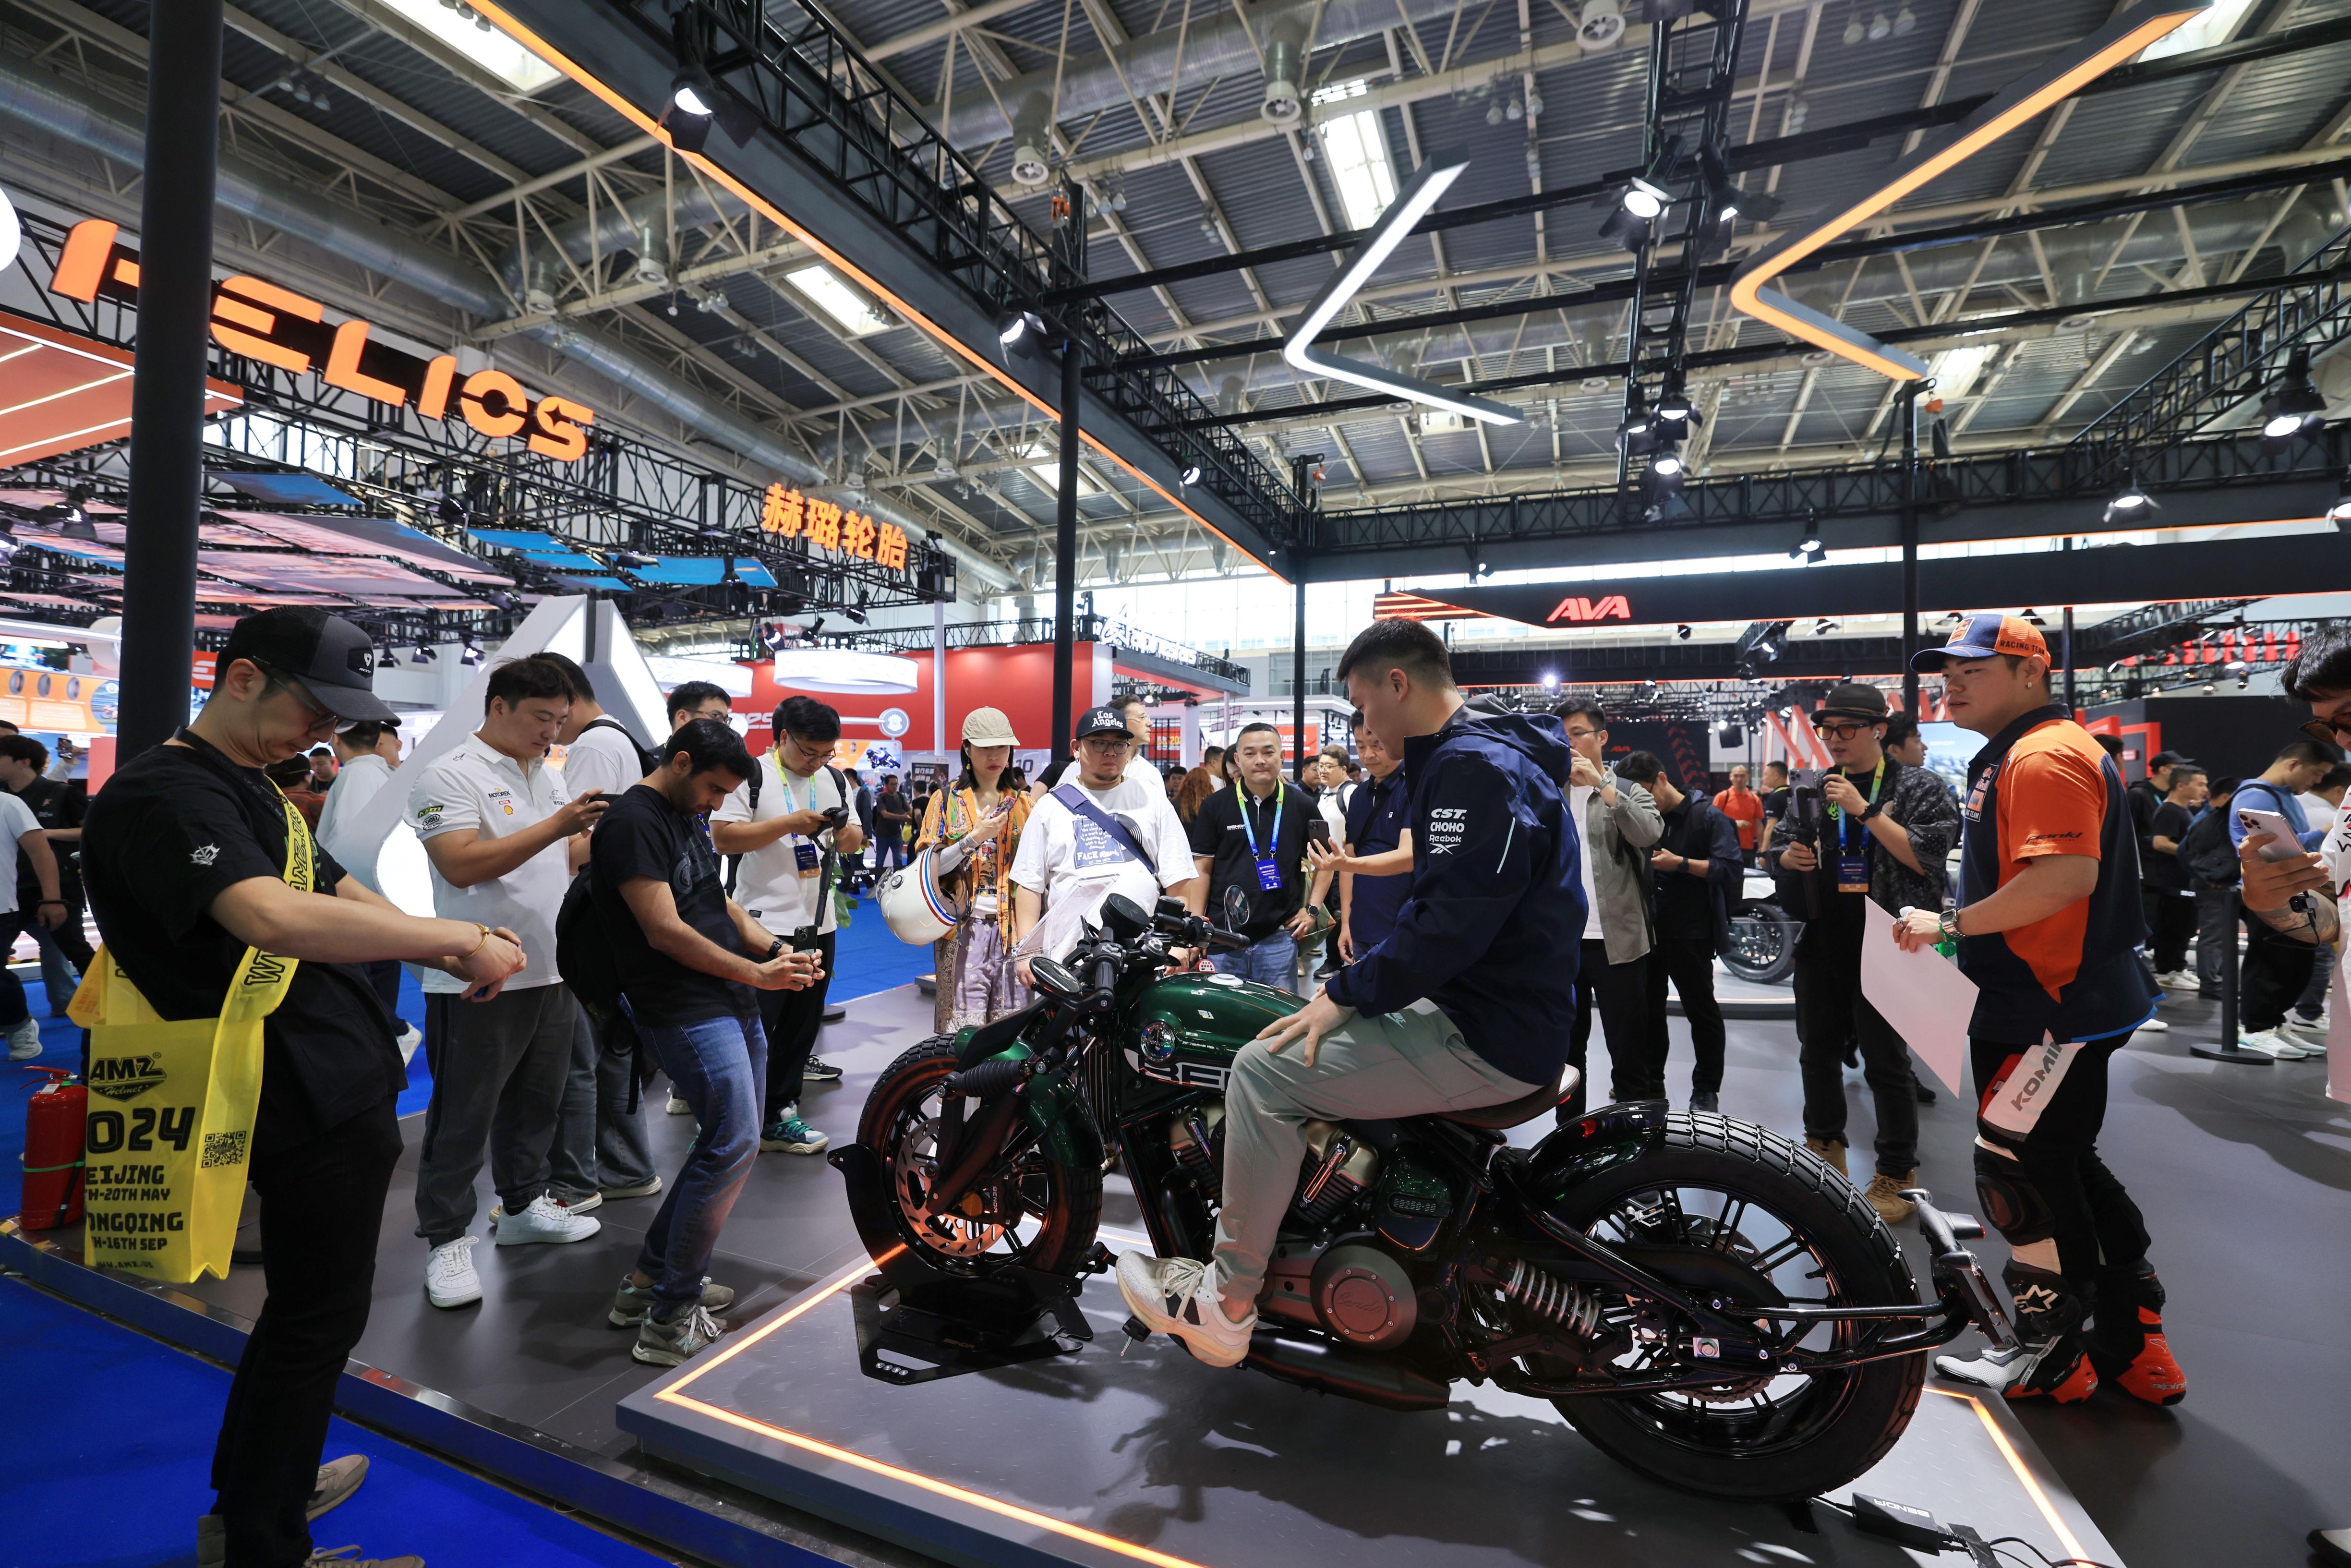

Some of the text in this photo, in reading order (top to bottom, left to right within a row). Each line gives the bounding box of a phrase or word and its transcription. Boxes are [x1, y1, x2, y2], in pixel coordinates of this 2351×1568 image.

[762, 482, 908, 571] 赫璐轮胎
[1546, 595, 1631, 622] AVA
[2000, 640, 2045, 655] RACING TEAM
[1097, 711, 1113, 720] Los
[1092, 717, 1123, 729] Angeles
[488, 790, 511, 798] MOTOREX
[425, 815, 438, 825] SHOEI
[1430, 822, 1465, 832] CHOHO
[1429, 834, 1461, 843] Reebok
[1077, 851, 1098, 861] FACE
[90, 1056, 167, 1083] AMZ
[104, 1084, 143, 1096] Helmet
[85, 1188, 170, 1201] H-20TH MAY
[140, 1237, 167, 1251] SEP
[1873, 1497, 1930, 1518] BENDA
